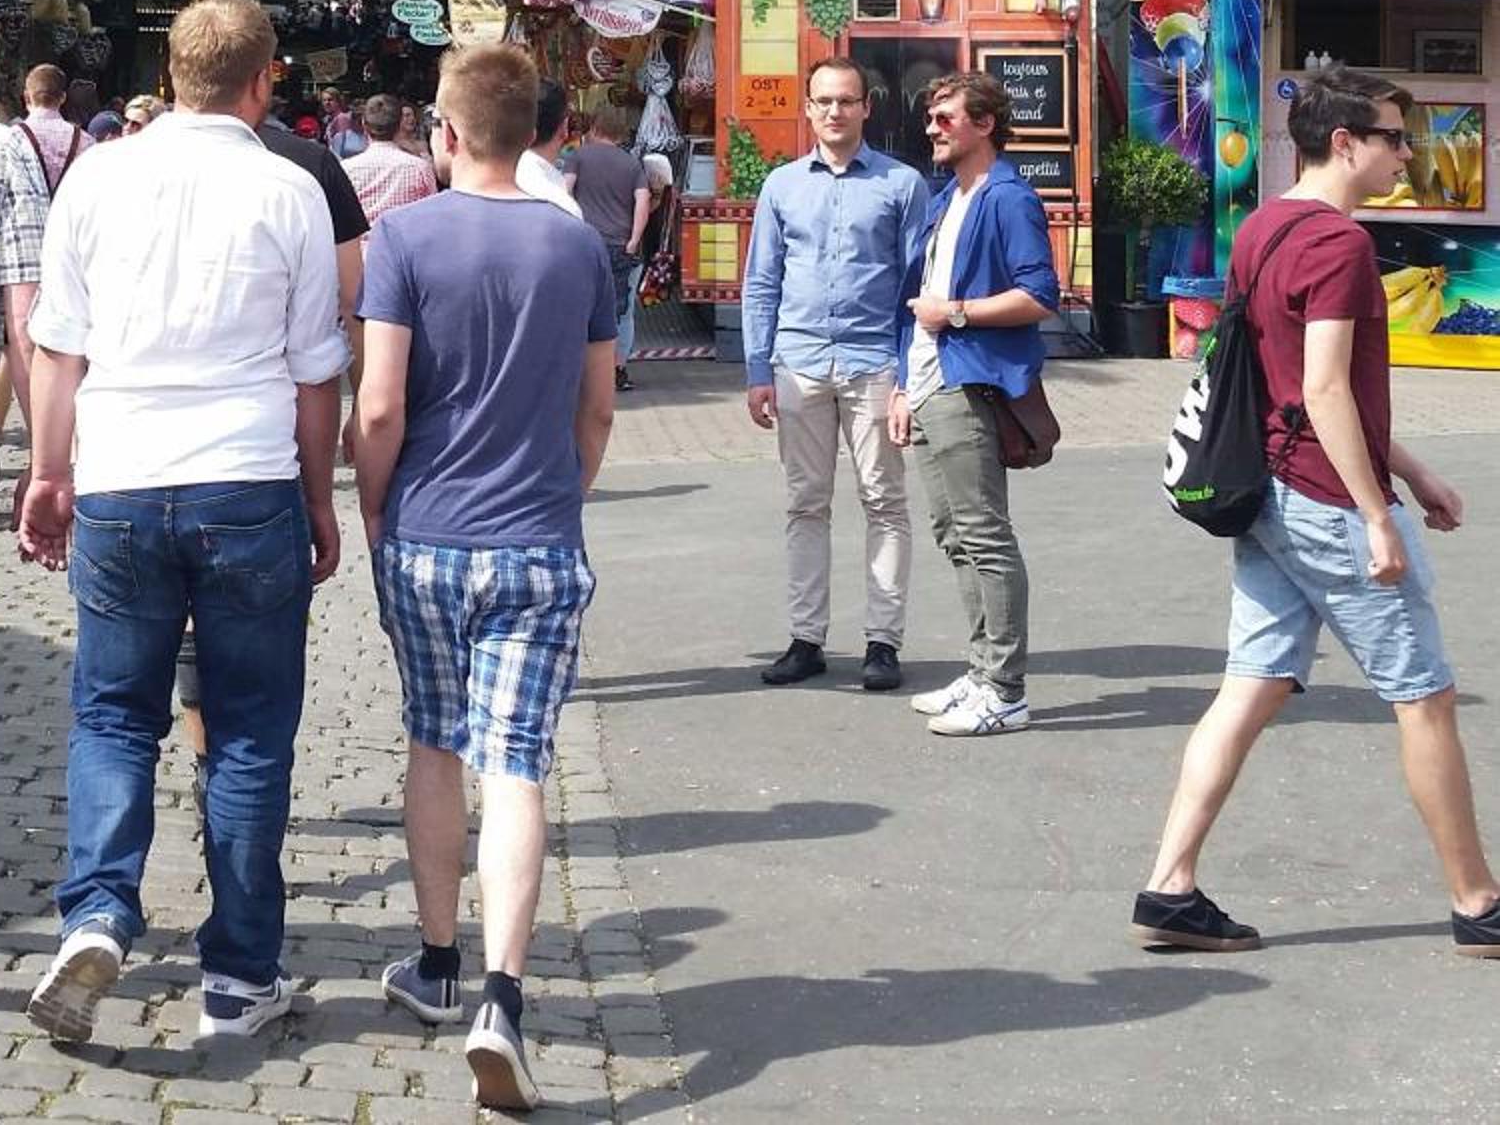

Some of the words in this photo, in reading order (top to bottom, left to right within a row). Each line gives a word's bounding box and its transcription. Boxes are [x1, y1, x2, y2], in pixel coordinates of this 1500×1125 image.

[1002, 59, 1049, 82] toujours
[751, 78, 781, 92] OST
[745, 95, 756, 108] 2
[771, 95, 788, 108] 14
